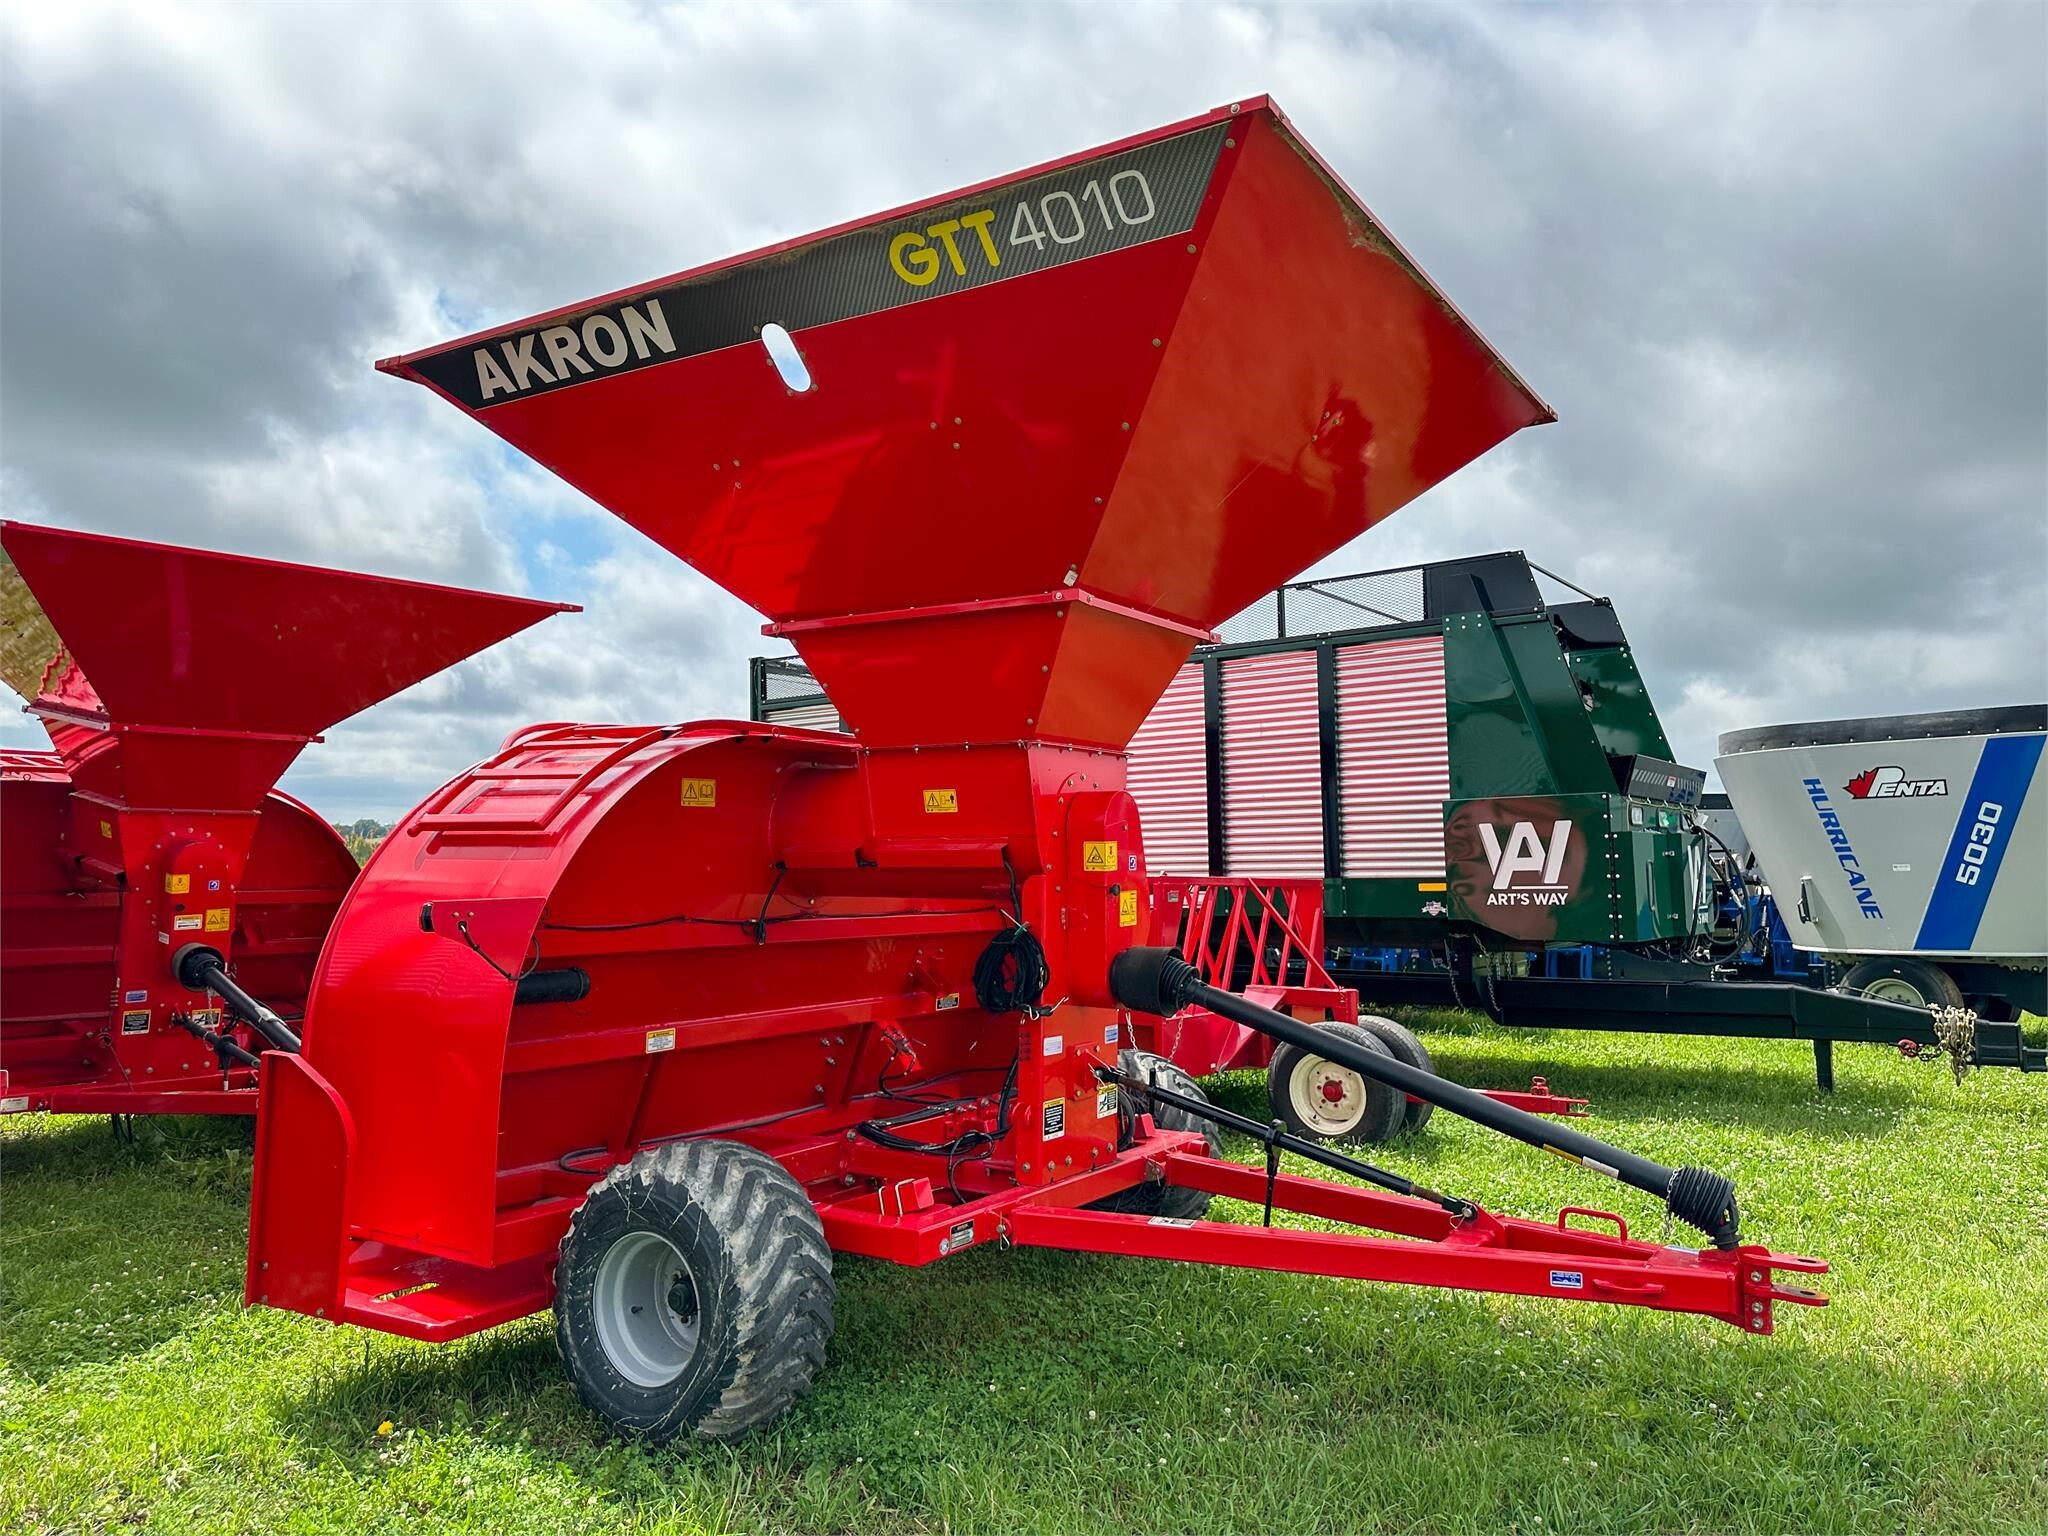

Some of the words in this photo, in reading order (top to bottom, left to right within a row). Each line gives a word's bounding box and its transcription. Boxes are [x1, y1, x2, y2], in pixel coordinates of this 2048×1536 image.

[889, 209, 1000, 286] GTT
[1009, 169, 1156, 251] 4010
[472, 299, 677, 400] AKRON
[1865, 766, 1948, 798] PENTA
[1803, 778, 1884, 920] HURRICANE
[1956, 801, 2003, 886] 5030
[1487, 893, 1530, 906] ART'S
[1533, 893, 1568, 906] WAY
